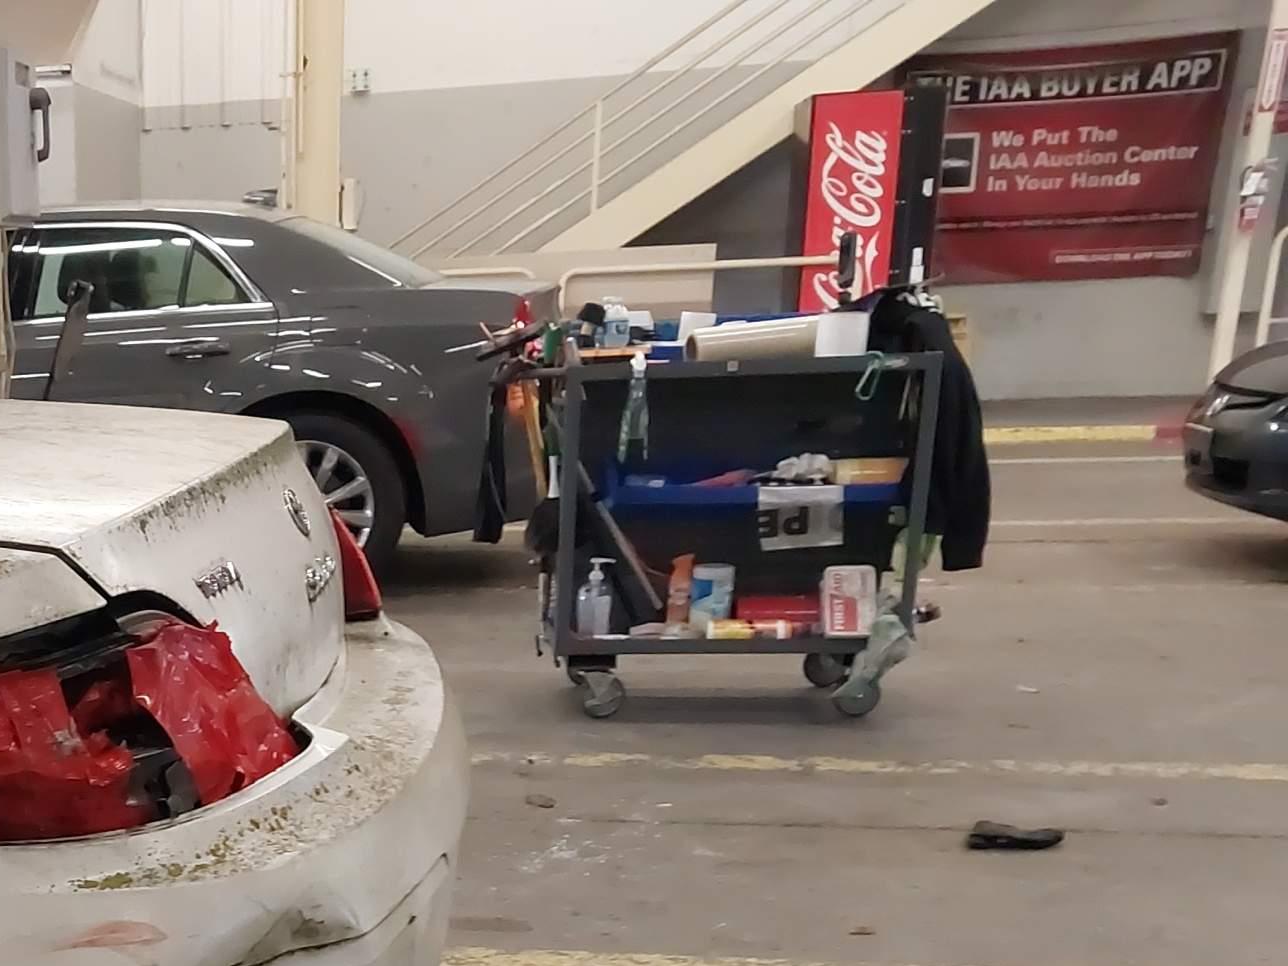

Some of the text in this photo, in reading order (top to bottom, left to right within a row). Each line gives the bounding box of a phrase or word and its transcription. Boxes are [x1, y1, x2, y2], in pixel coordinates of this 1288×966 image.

[979, 74, 1031, 100] IAA
[1039, 66, 1141, 99] BUYER
[1146, 57, 1212, 91] APP
[991, 126, 1118, 148] We Put The
[989, 146, 1199, 170] IAA Auction Center
[986, 169, 1142, 192] In Your Hands
